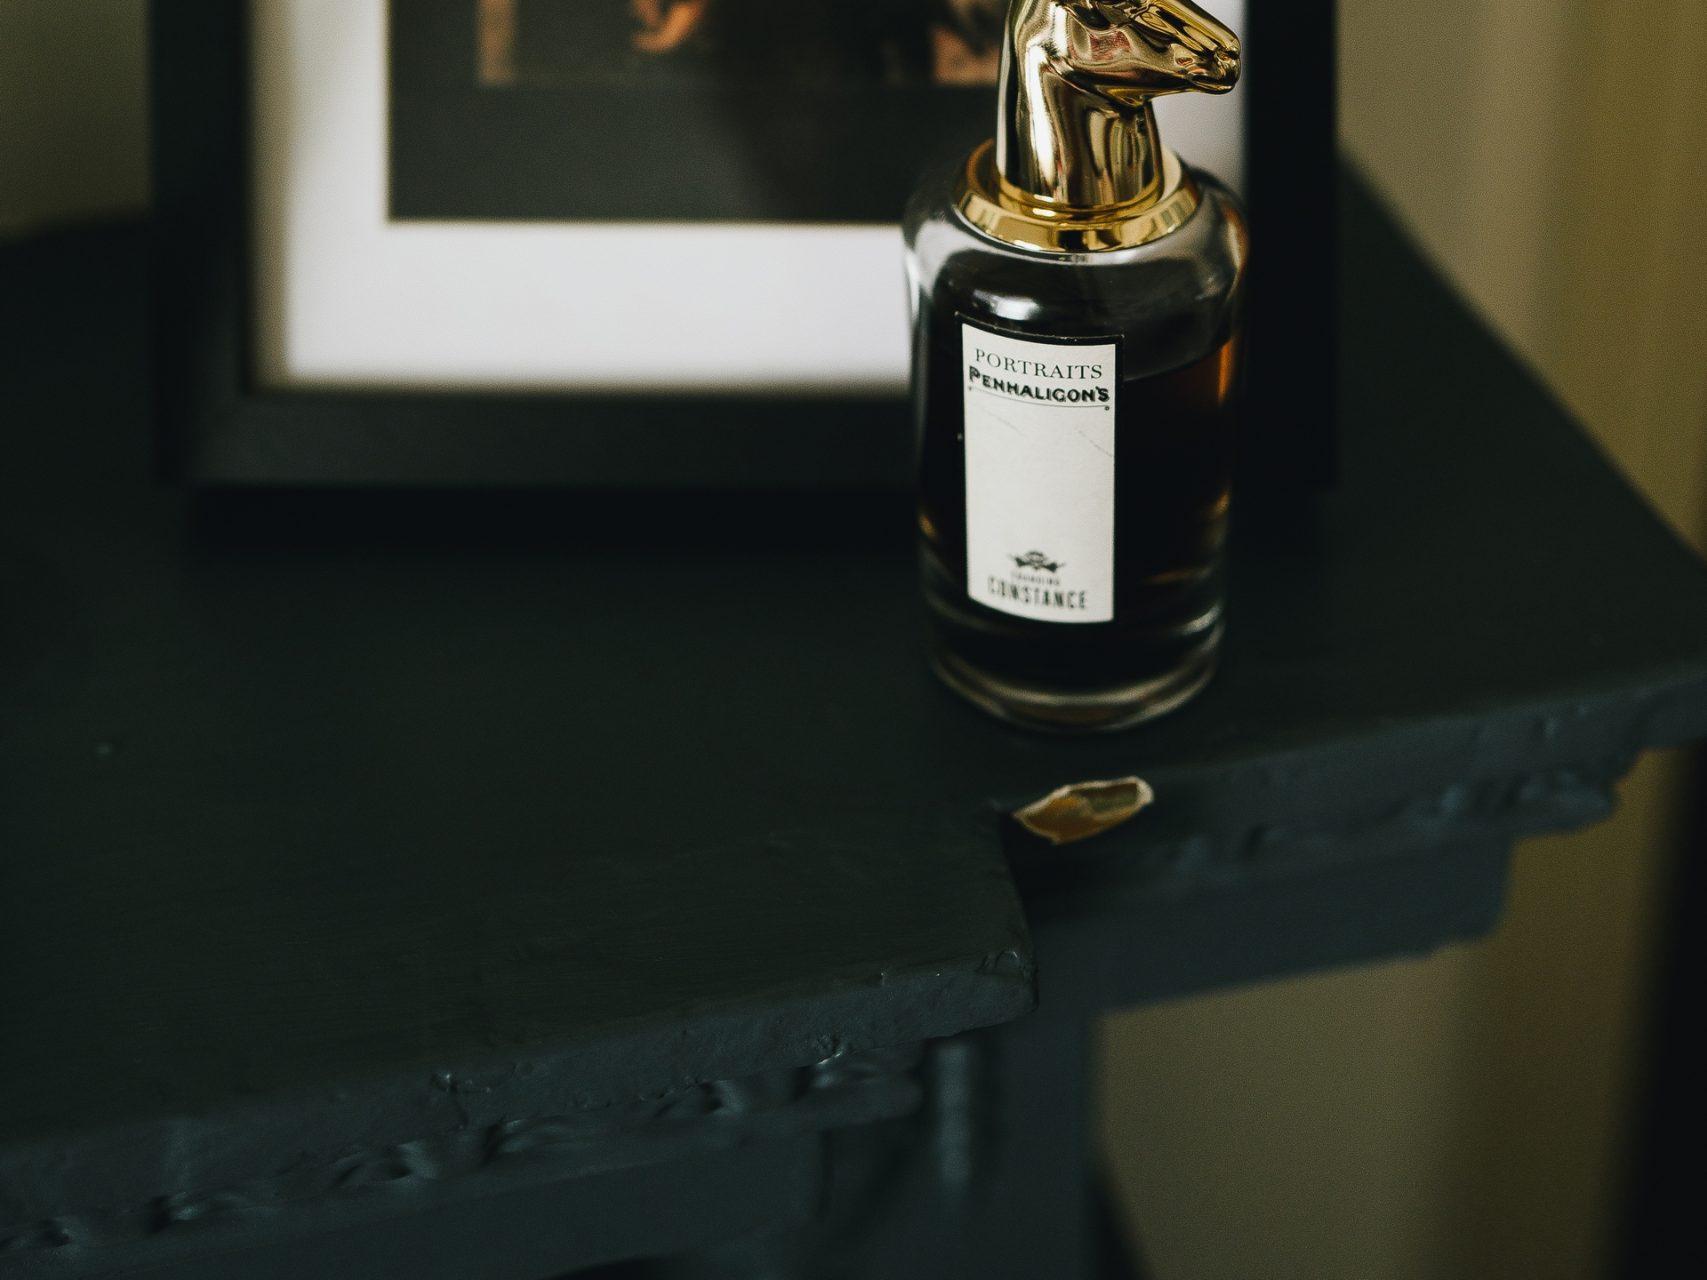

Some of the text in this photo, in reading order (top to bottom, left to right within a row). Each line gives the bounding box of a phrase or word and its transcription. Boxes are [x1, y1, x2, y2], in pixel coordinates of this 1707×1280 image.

[975, 347, 1103, 380] PORTRAITS
[969, 365, 1110, 403] PENHALIGON'S
[988, 576, 1088, 609] CONSTANCE
